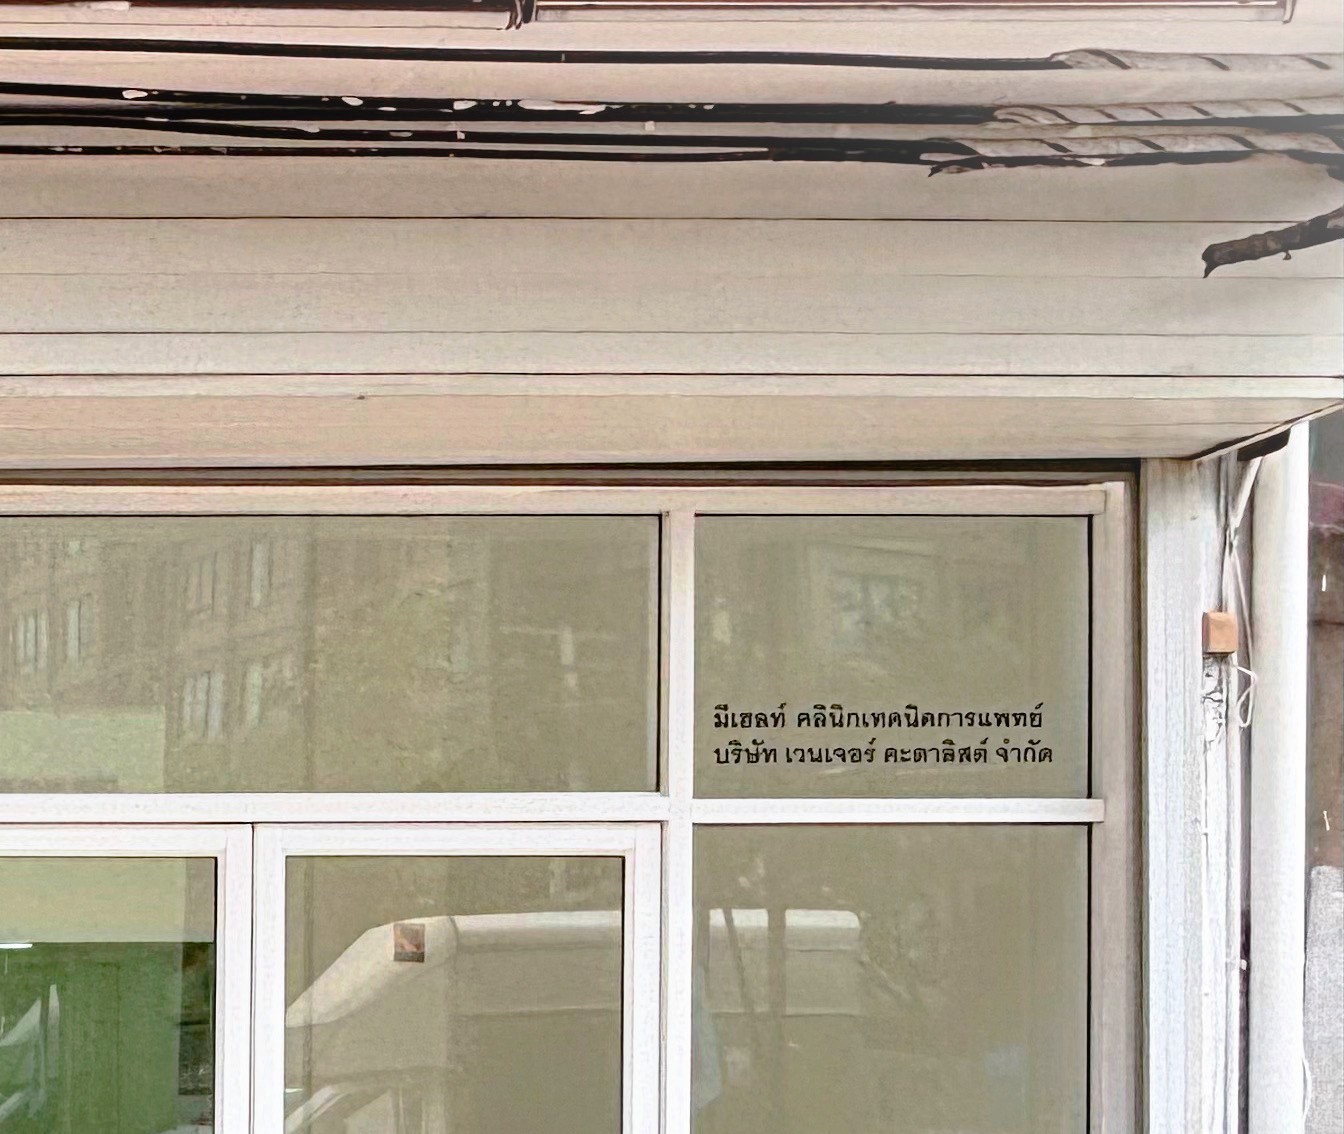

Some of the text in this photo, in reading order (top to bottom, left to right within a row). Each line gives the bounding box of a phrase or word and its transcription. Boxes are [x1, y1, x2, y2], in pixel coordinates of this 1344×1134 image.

[713, 701, 1045, 729] มีเฮลท์ คลินิกเทคนิคการแพทย์
[713, 738, 778, 764] บริษัท
[995, 738, 1054, 763] จำกัด
